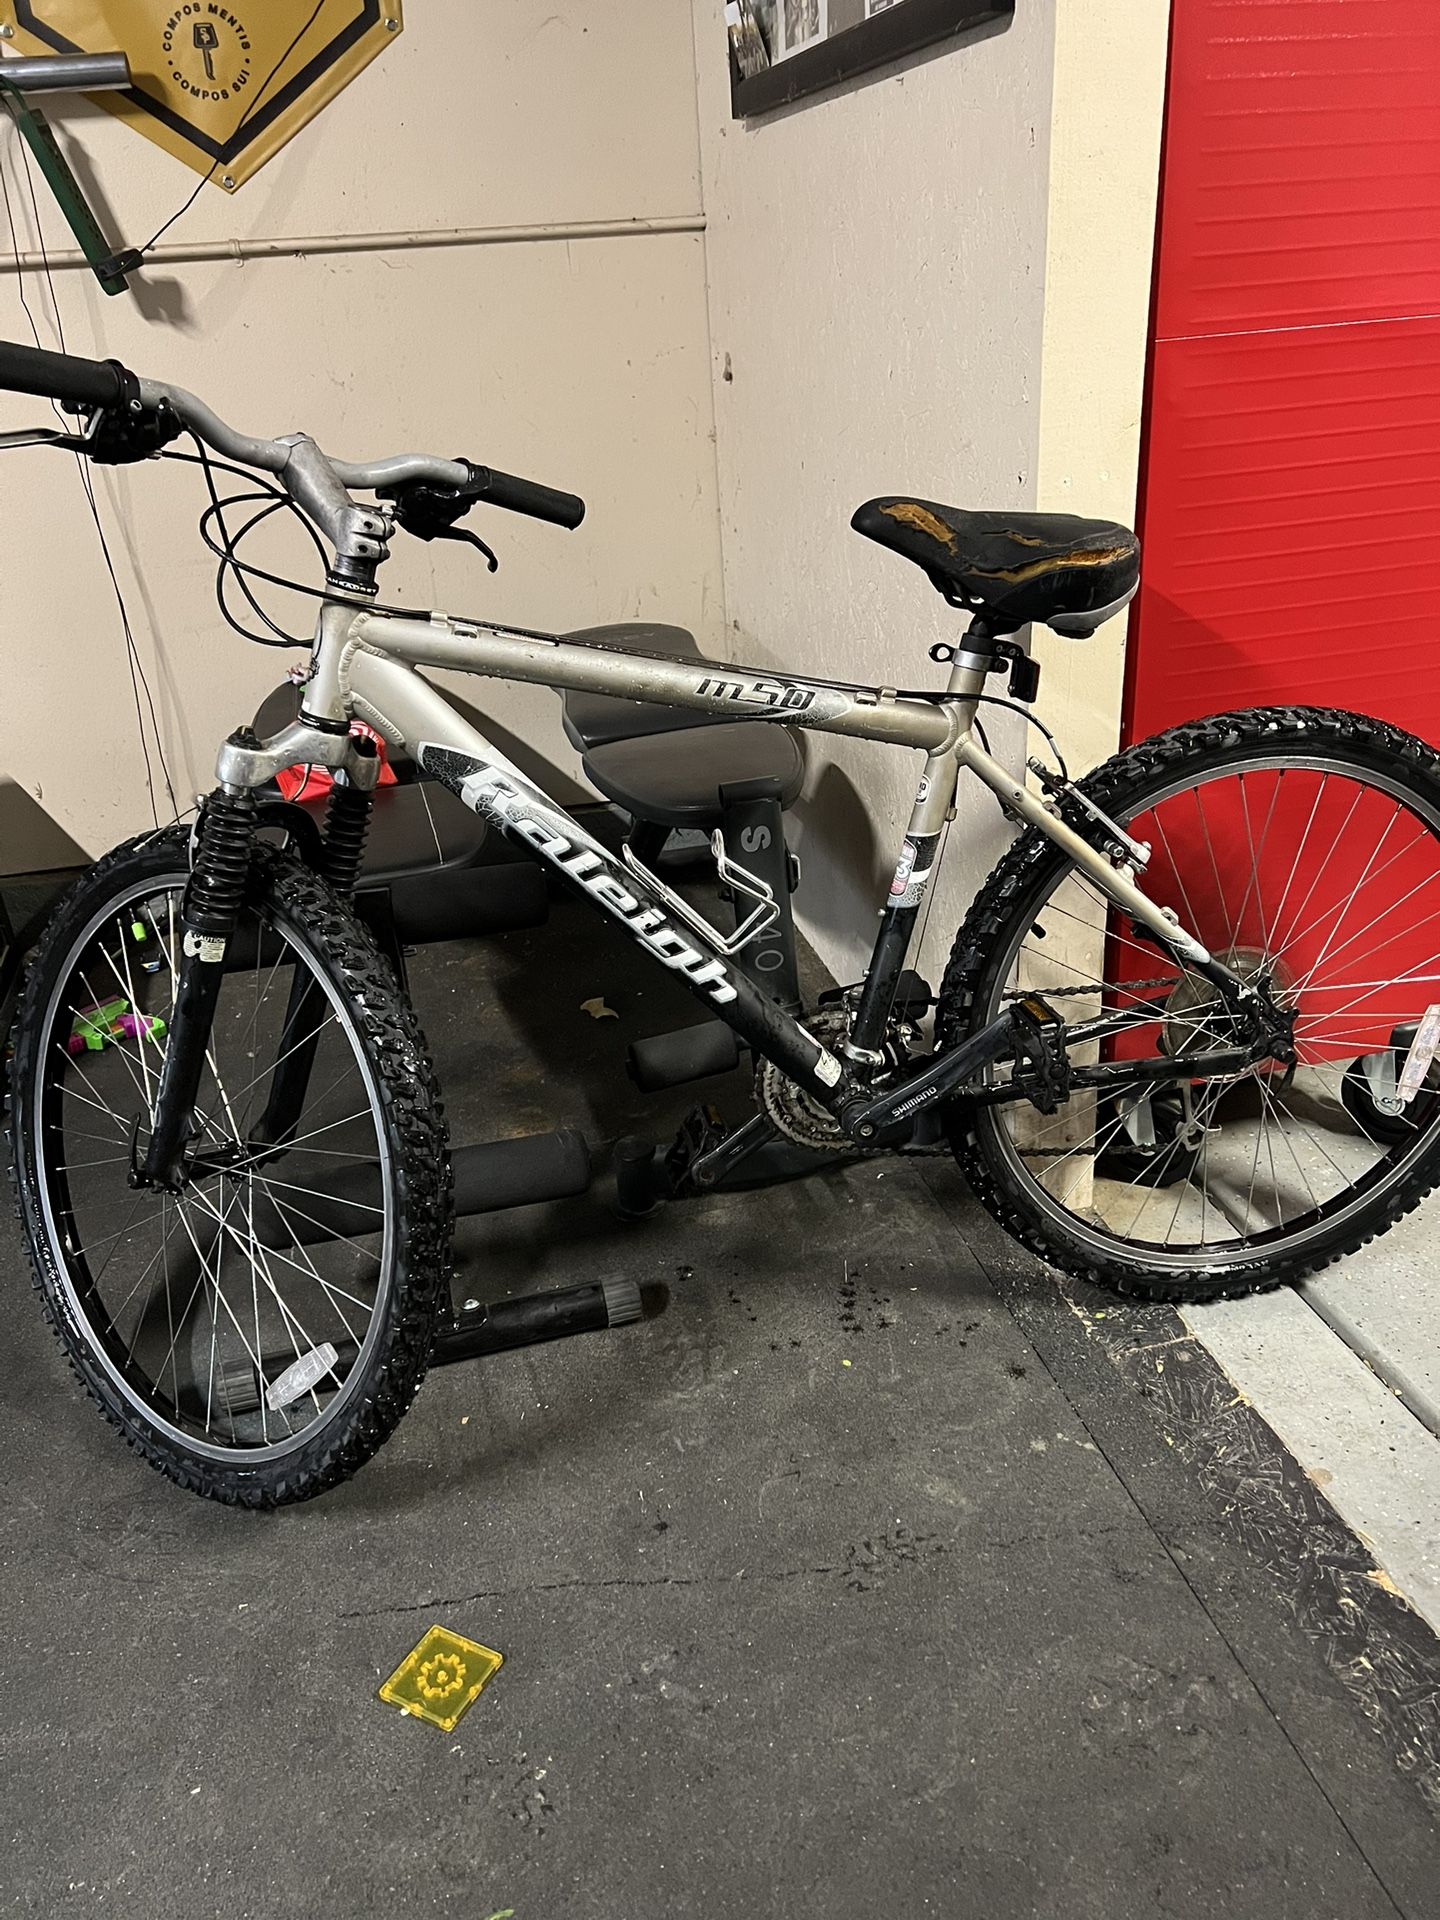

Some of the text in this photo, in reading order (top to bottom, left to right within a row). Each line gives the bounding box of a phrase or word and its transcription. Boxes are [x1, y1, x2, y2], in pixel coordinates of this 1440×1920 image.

[162, 2, 251, 52] COMPOS MENTIS
[172, 69, 250, 101] COMPOS SUI
[461, 765, 738, 1004] Raleigh
[891, 1086, 937, 1117] SHIMANO
